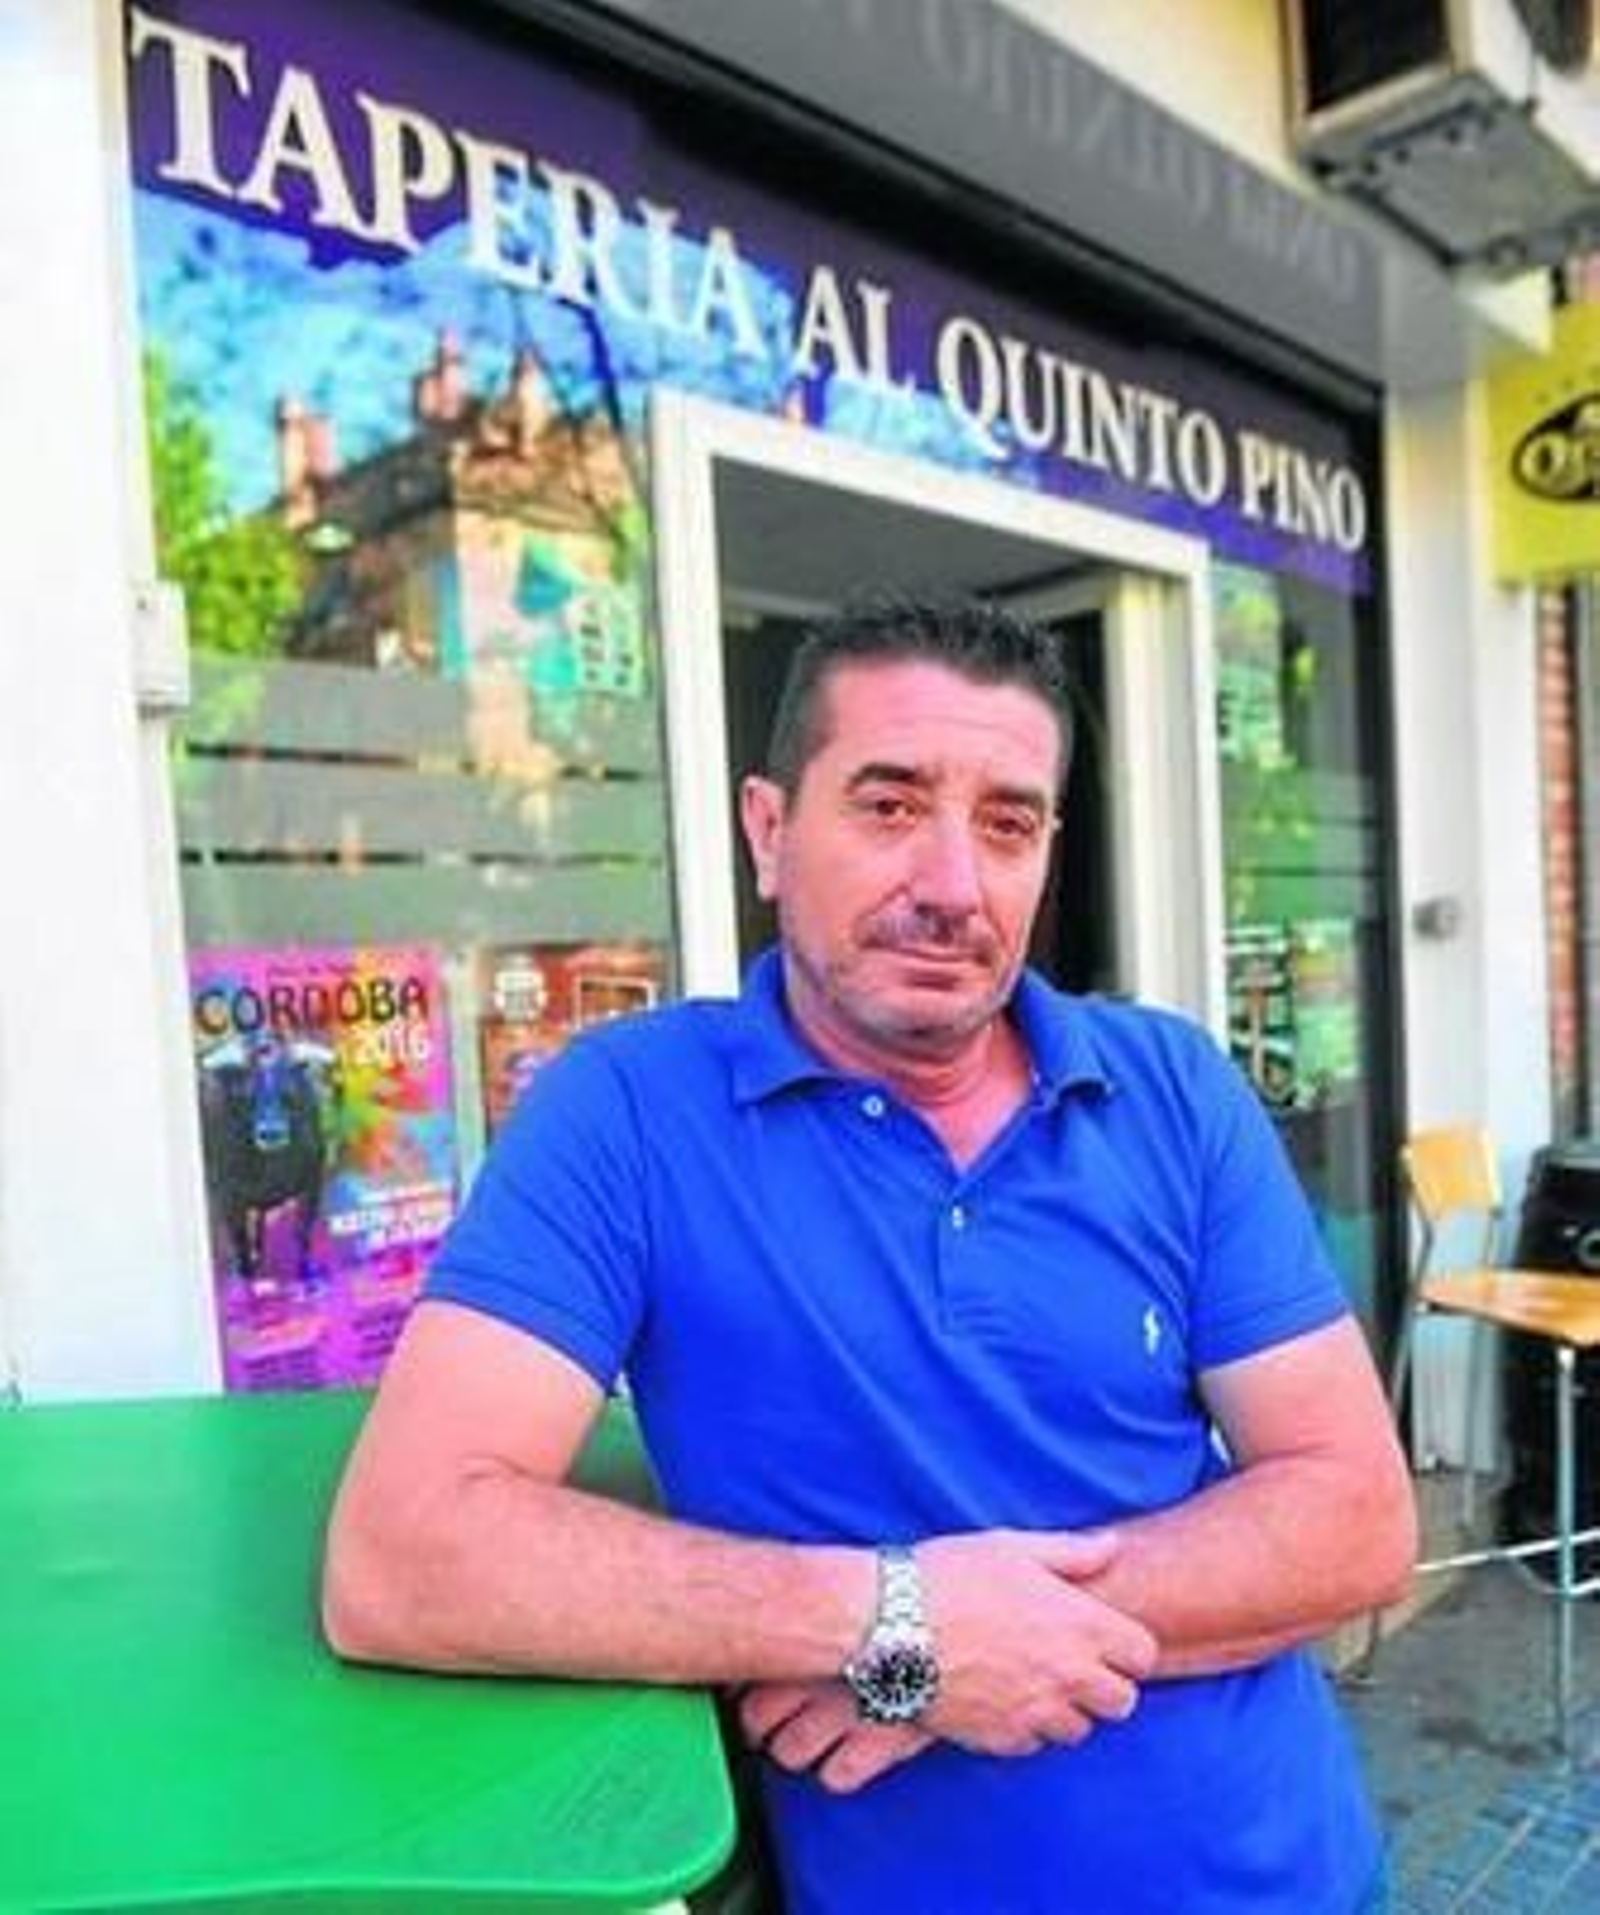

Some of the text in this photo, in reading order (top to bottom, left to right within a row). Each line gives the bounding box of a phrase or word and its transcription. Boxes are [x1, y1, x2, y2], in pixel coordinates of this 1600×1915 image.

[131, 8, 768, 361] TAPERIA
[794, 265, 917, 399] AL
[937, 316, 1227, 507] QUINTO
[1237, 430, 1367, 552] PINO
[194, 975, 430, 1036] CORDOBA
[353, 1018, 431, 1068] 2016
